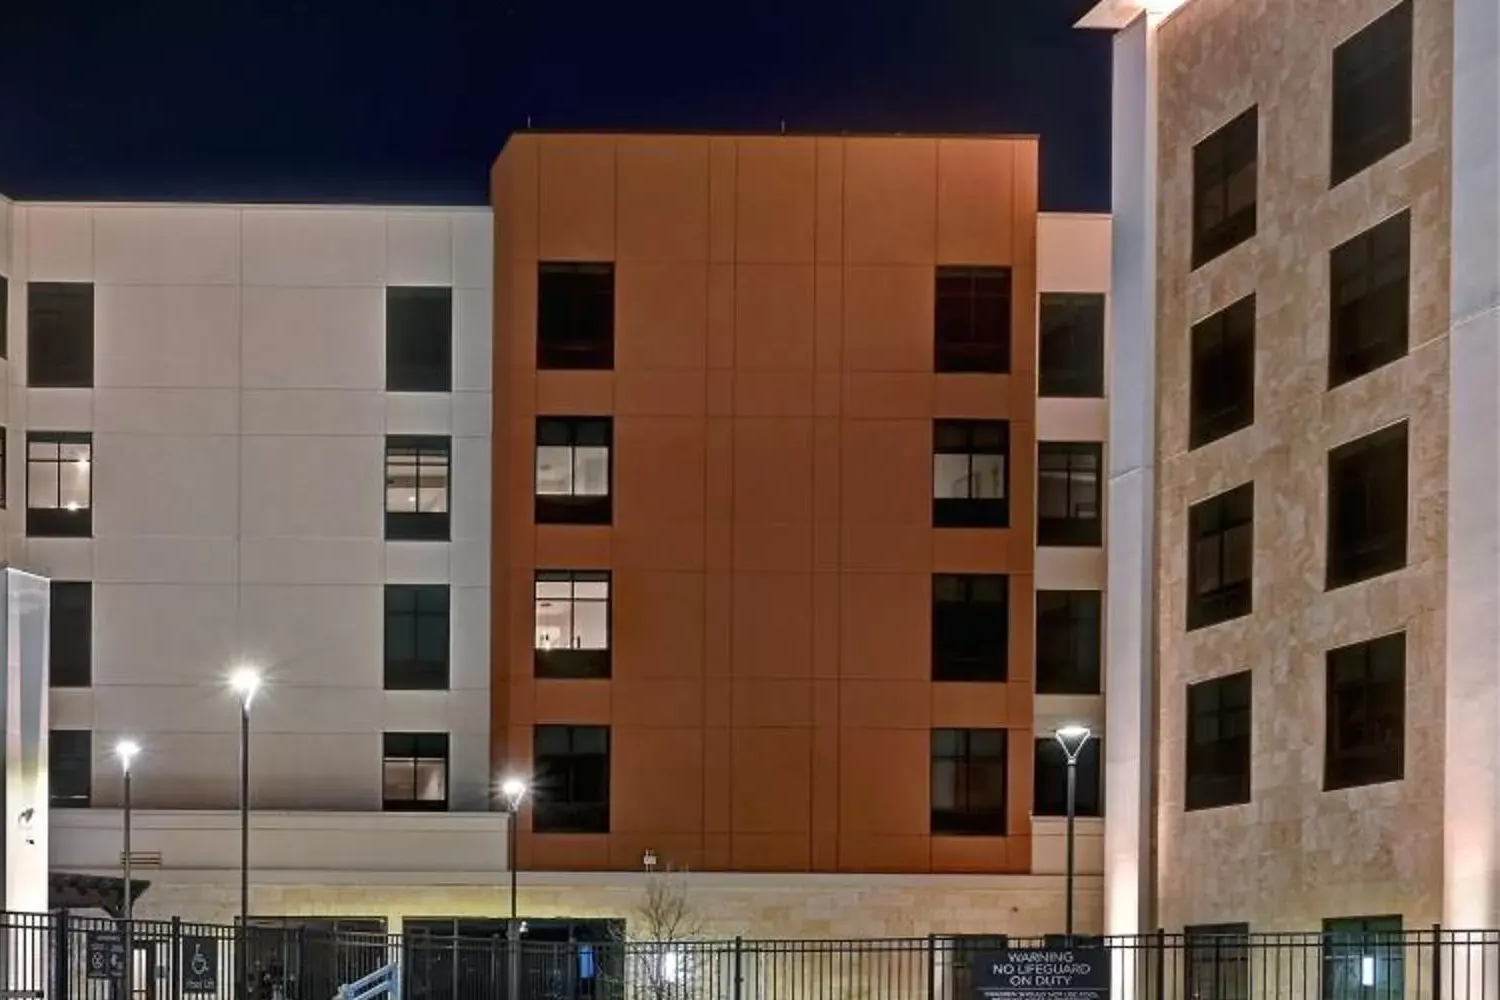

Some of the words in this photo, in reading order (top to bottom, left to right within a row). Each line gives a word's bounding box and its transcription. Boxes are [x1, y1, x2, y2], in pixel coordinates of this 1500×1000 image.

[1007, 951, 1074, 962] WARNING
[993, 963, 1015, 974] NO
[1018, 963, 1091, 975] LIFEGUARD
[1009, 975, 1032, 986] ON
[1035, 975, 1073, 986] DUTY
